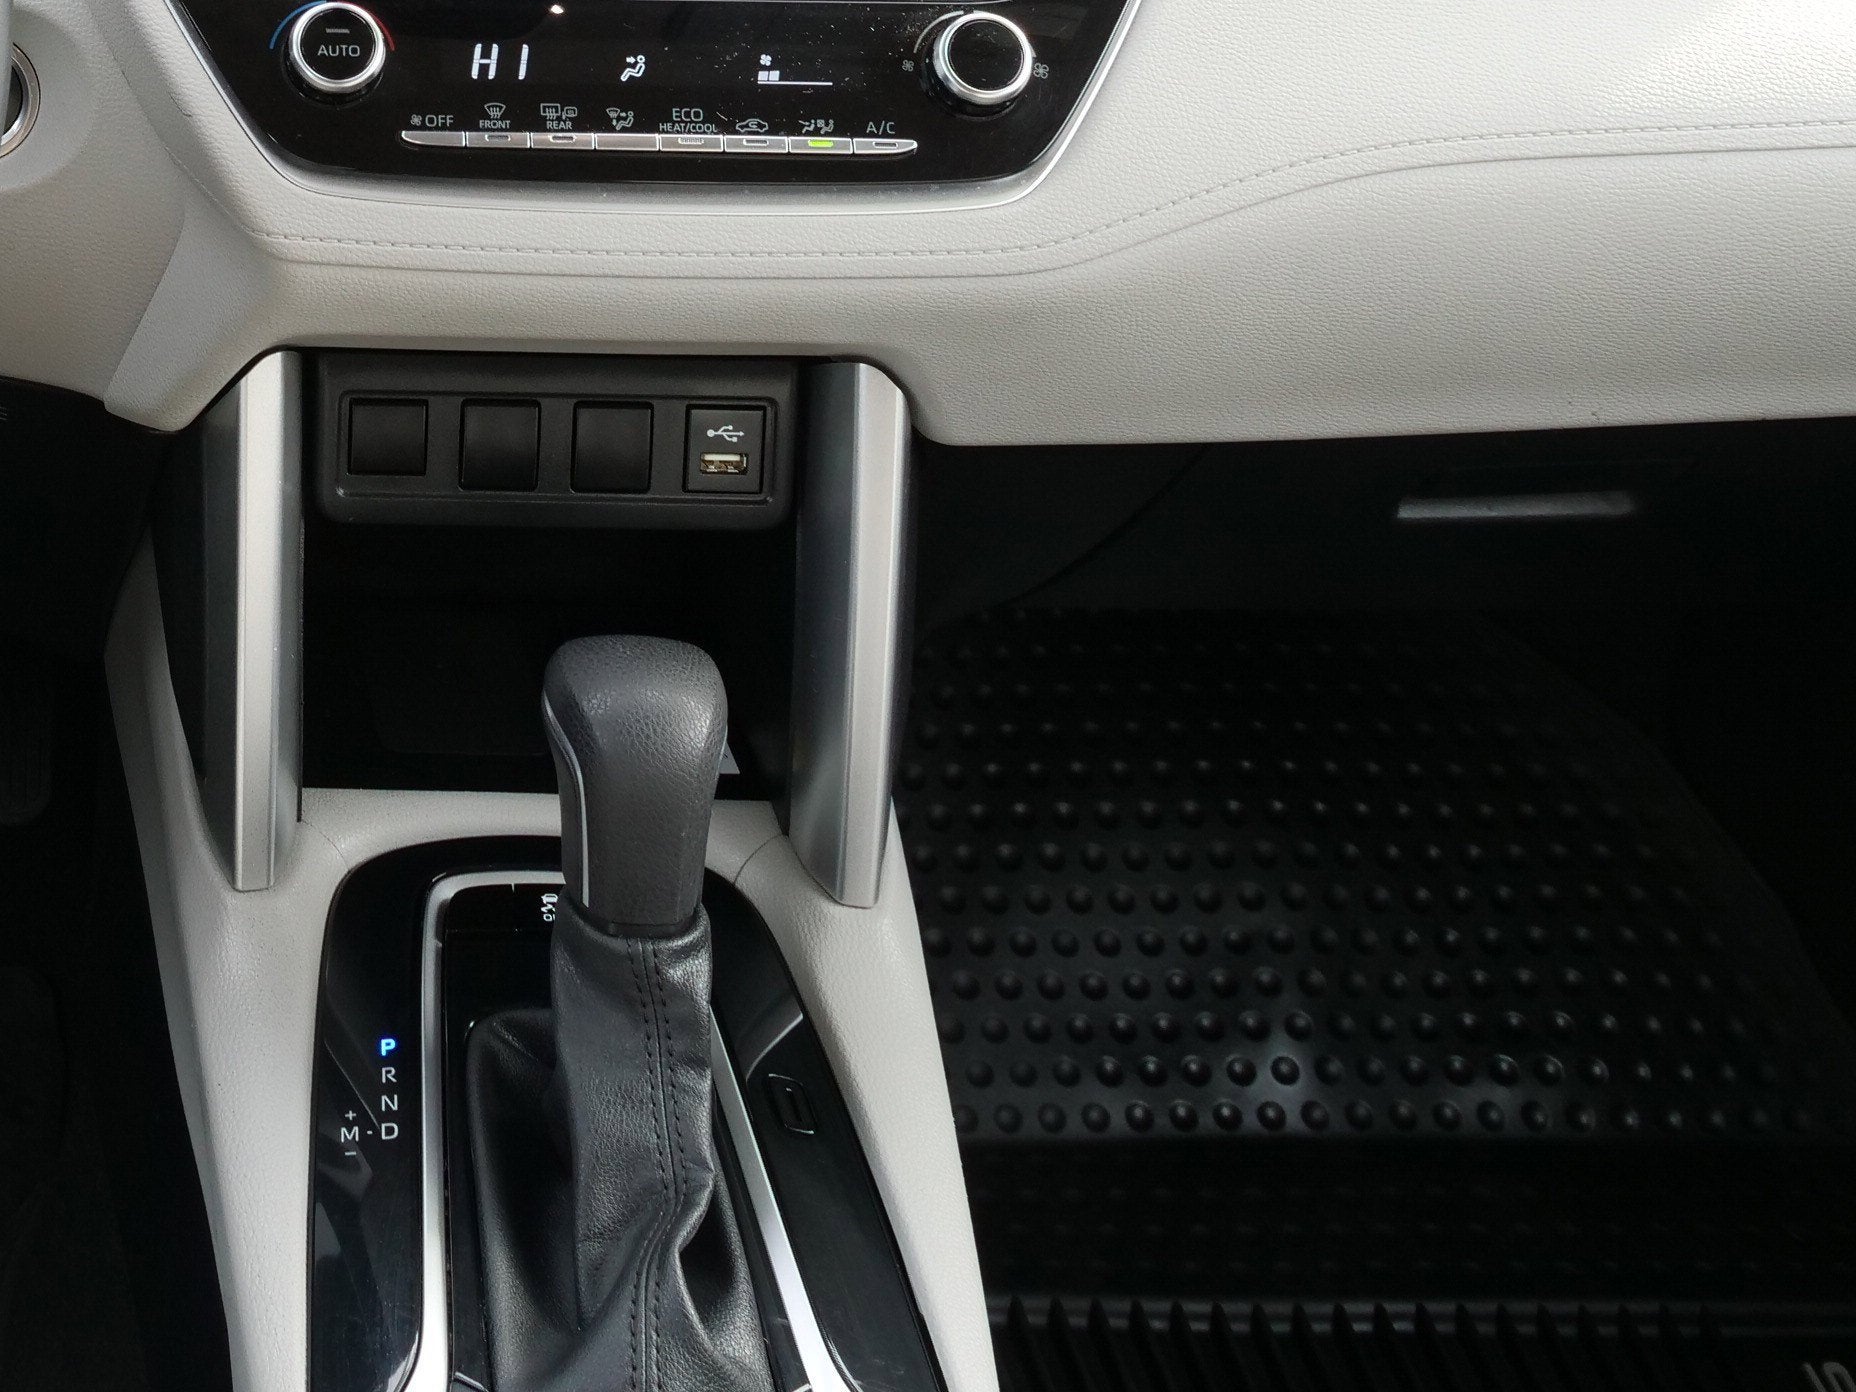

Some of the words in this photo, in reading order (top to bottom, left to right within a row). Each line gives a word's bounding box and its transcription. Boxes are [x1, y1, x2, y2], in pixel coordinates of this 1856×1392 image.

[317, 45, 361, 57] AUTO
[471, 43, 529, 80] HI
[425, 115, 454, 128] OFF
[672, 108, 704, 122] ECO
[479, 119, 510, 130] FRONT
[546, 120, 572, 130] REAR
[659, 123, 718, 133] HEAT/COOL
[866, 121, 896, 135] A/C
[380, 1038, 396, 1056] P
[382, 1067, 397, 1083] R
[381, 1095, 398, 1111] N
[341, 1127, 359, 1143] M
[381, 1124, 399, 1140] D
